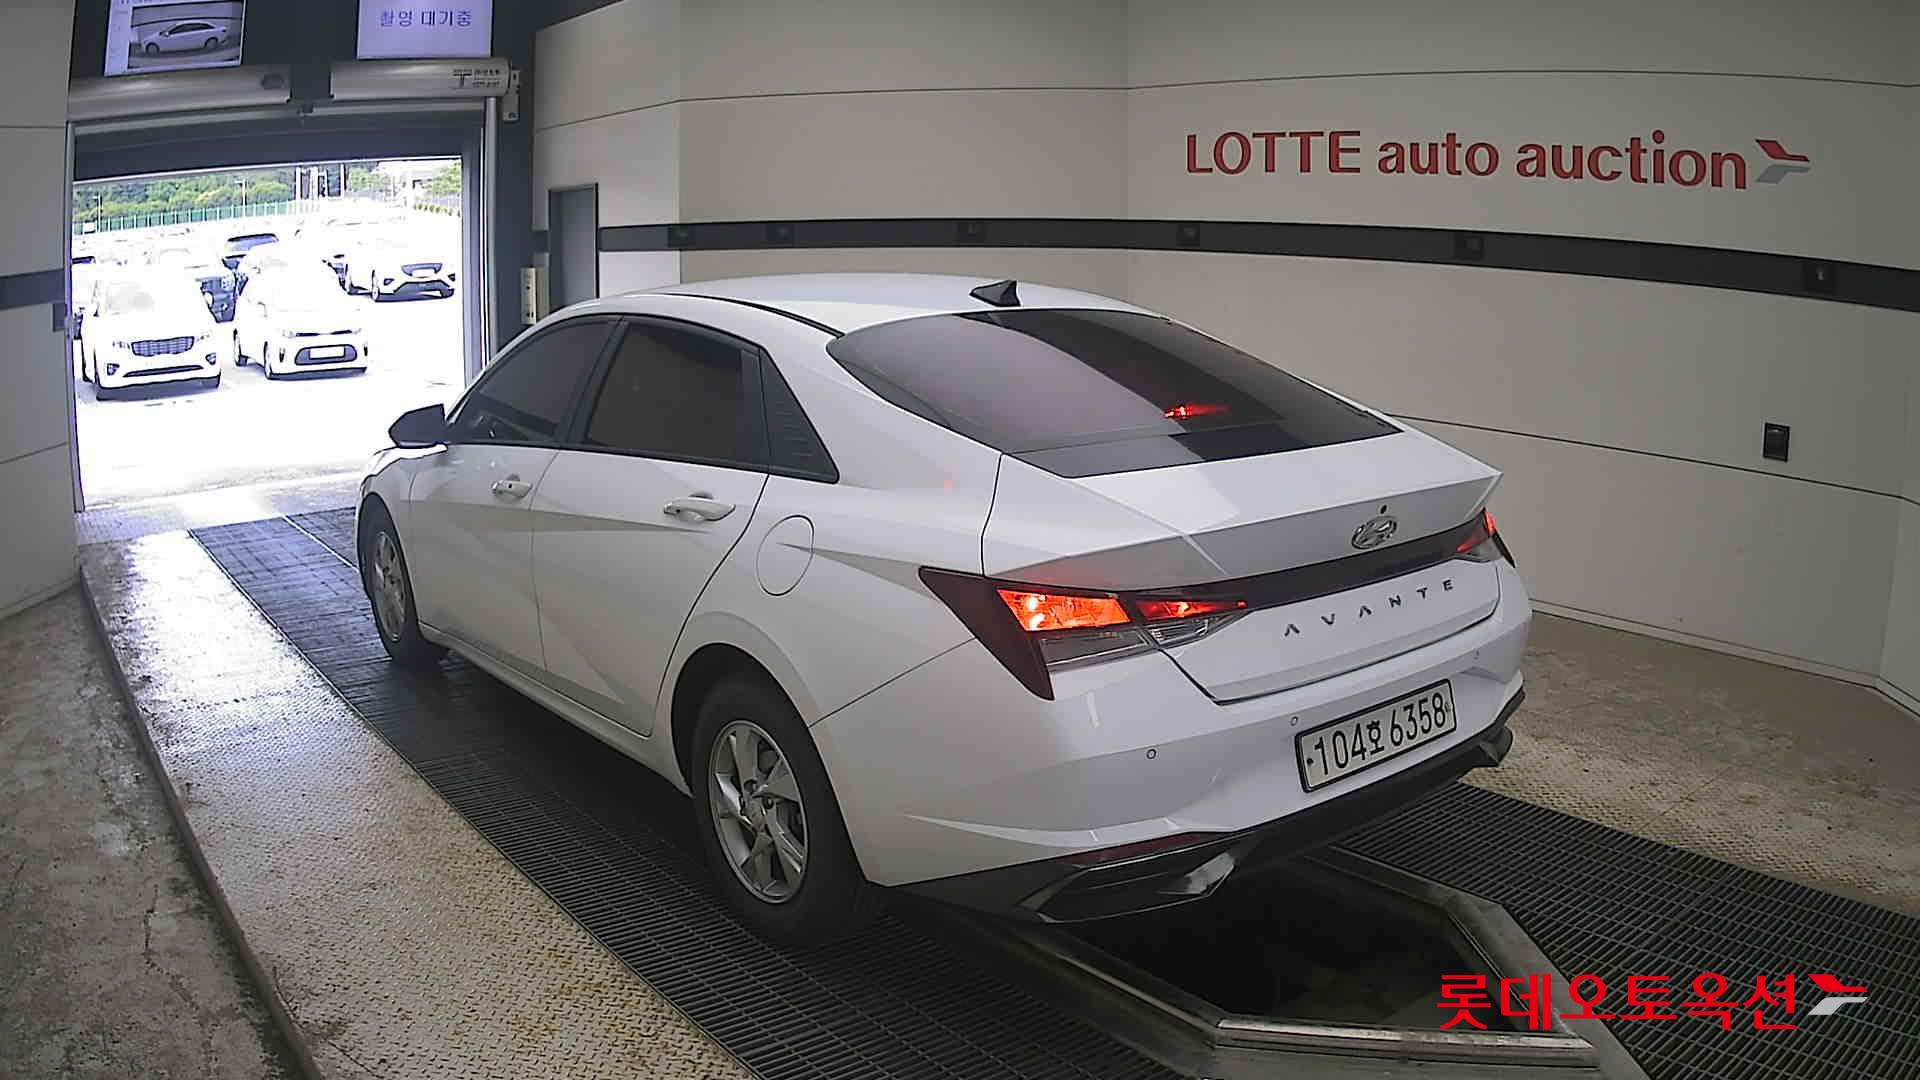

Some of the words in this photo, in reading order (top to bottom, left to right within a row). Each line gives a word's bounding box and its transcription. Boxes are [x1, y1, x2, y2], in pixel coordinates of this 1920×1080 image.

[421, 10, 472, 27] 대기중
[1186, 130, 1361, 175] LOTTE
[1377, 130, 1500, 176] auto
[1516, 128, 1748, 189] auction
[1284, 579, 1453, 637] AVANTE
